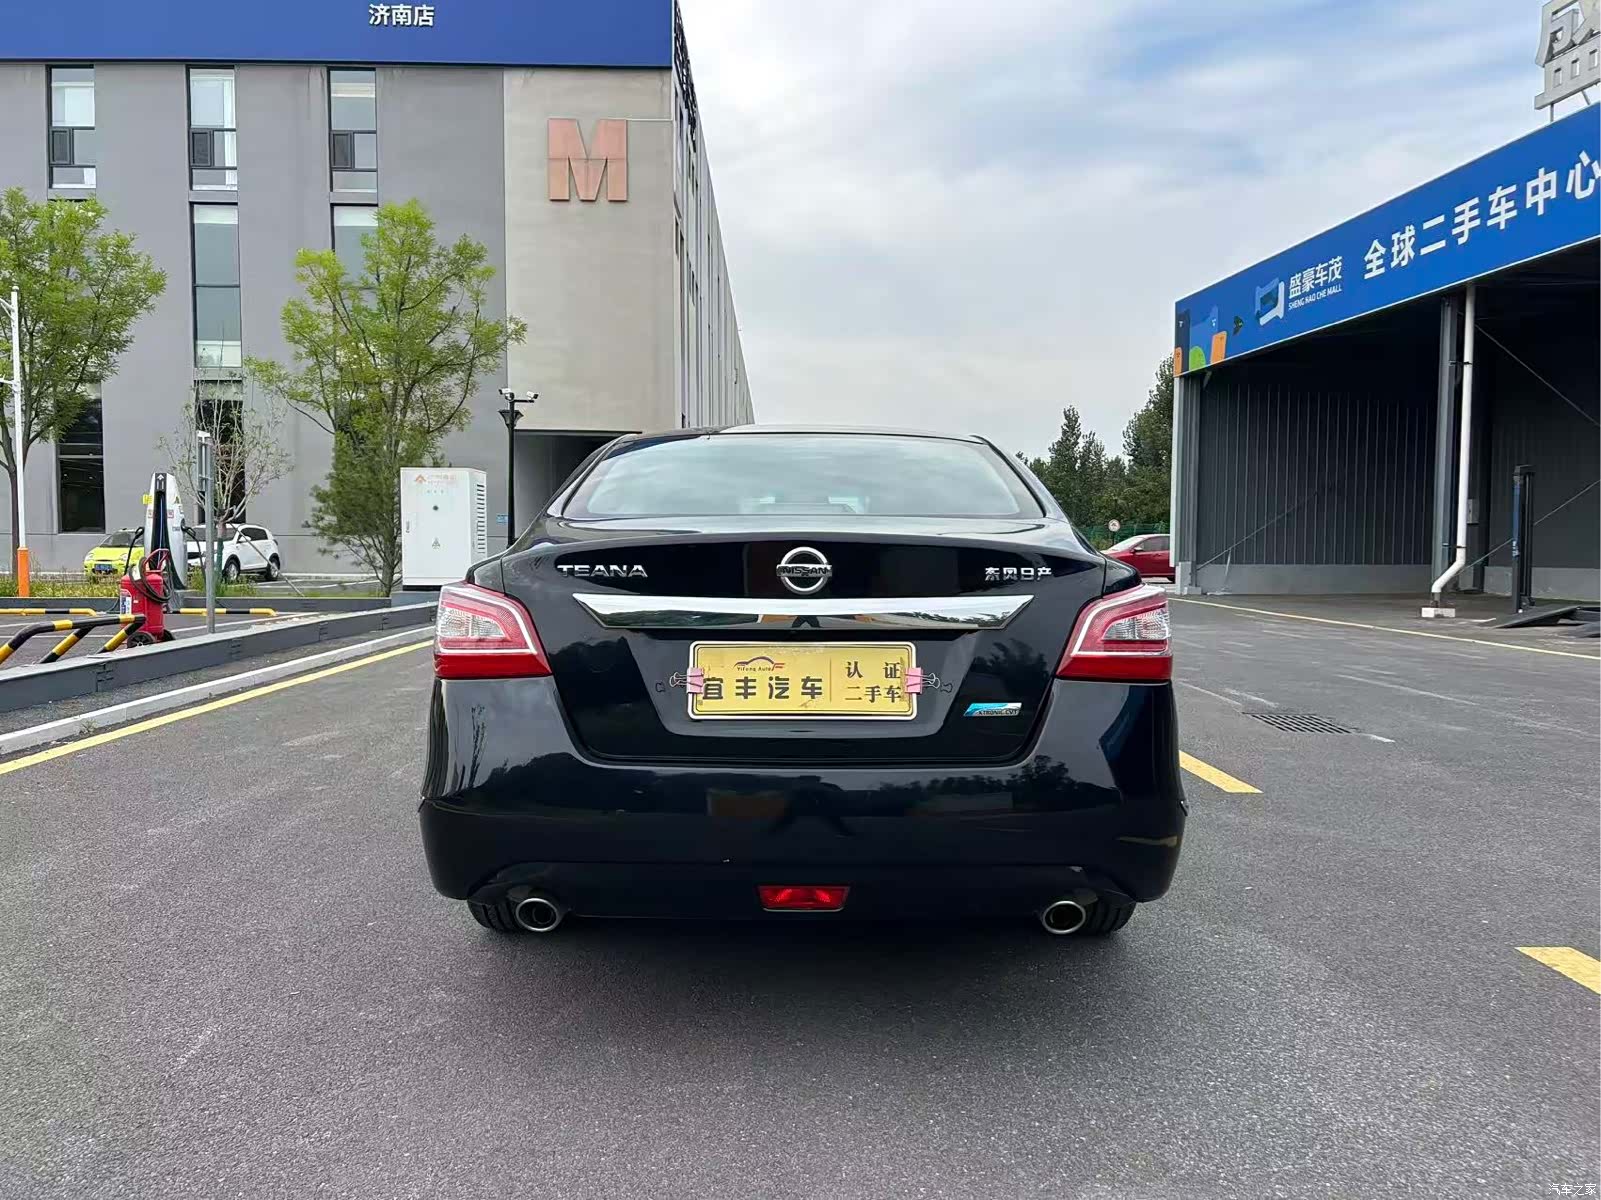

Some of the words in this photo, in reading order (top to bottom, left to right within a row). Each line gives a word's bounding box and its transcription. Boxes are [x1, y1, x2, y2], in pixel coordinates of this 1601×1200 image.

[368, 3, 435, 26] 济南店
[547, 117, 628, 202] M
[1364, 150, 1601, 280] 全球二手车中心
[1289, 256, 1342, 299] 盛豪车茂
[1288, 298, 1304, 310] SHENG
[1316, 288, 1327, 300] CHE
[1327, 283, 1343, 296] MALL
[557, 564, 648, 578] TEANA
[781, 565, 828, 575] NISSAN
[985, 566, 1052, 581] 东风日产
[845, 661, 901, 680] 认证
[702, 676, 823, 700] 宜丰汽车
[845, 685, 901, 703] 二手车
